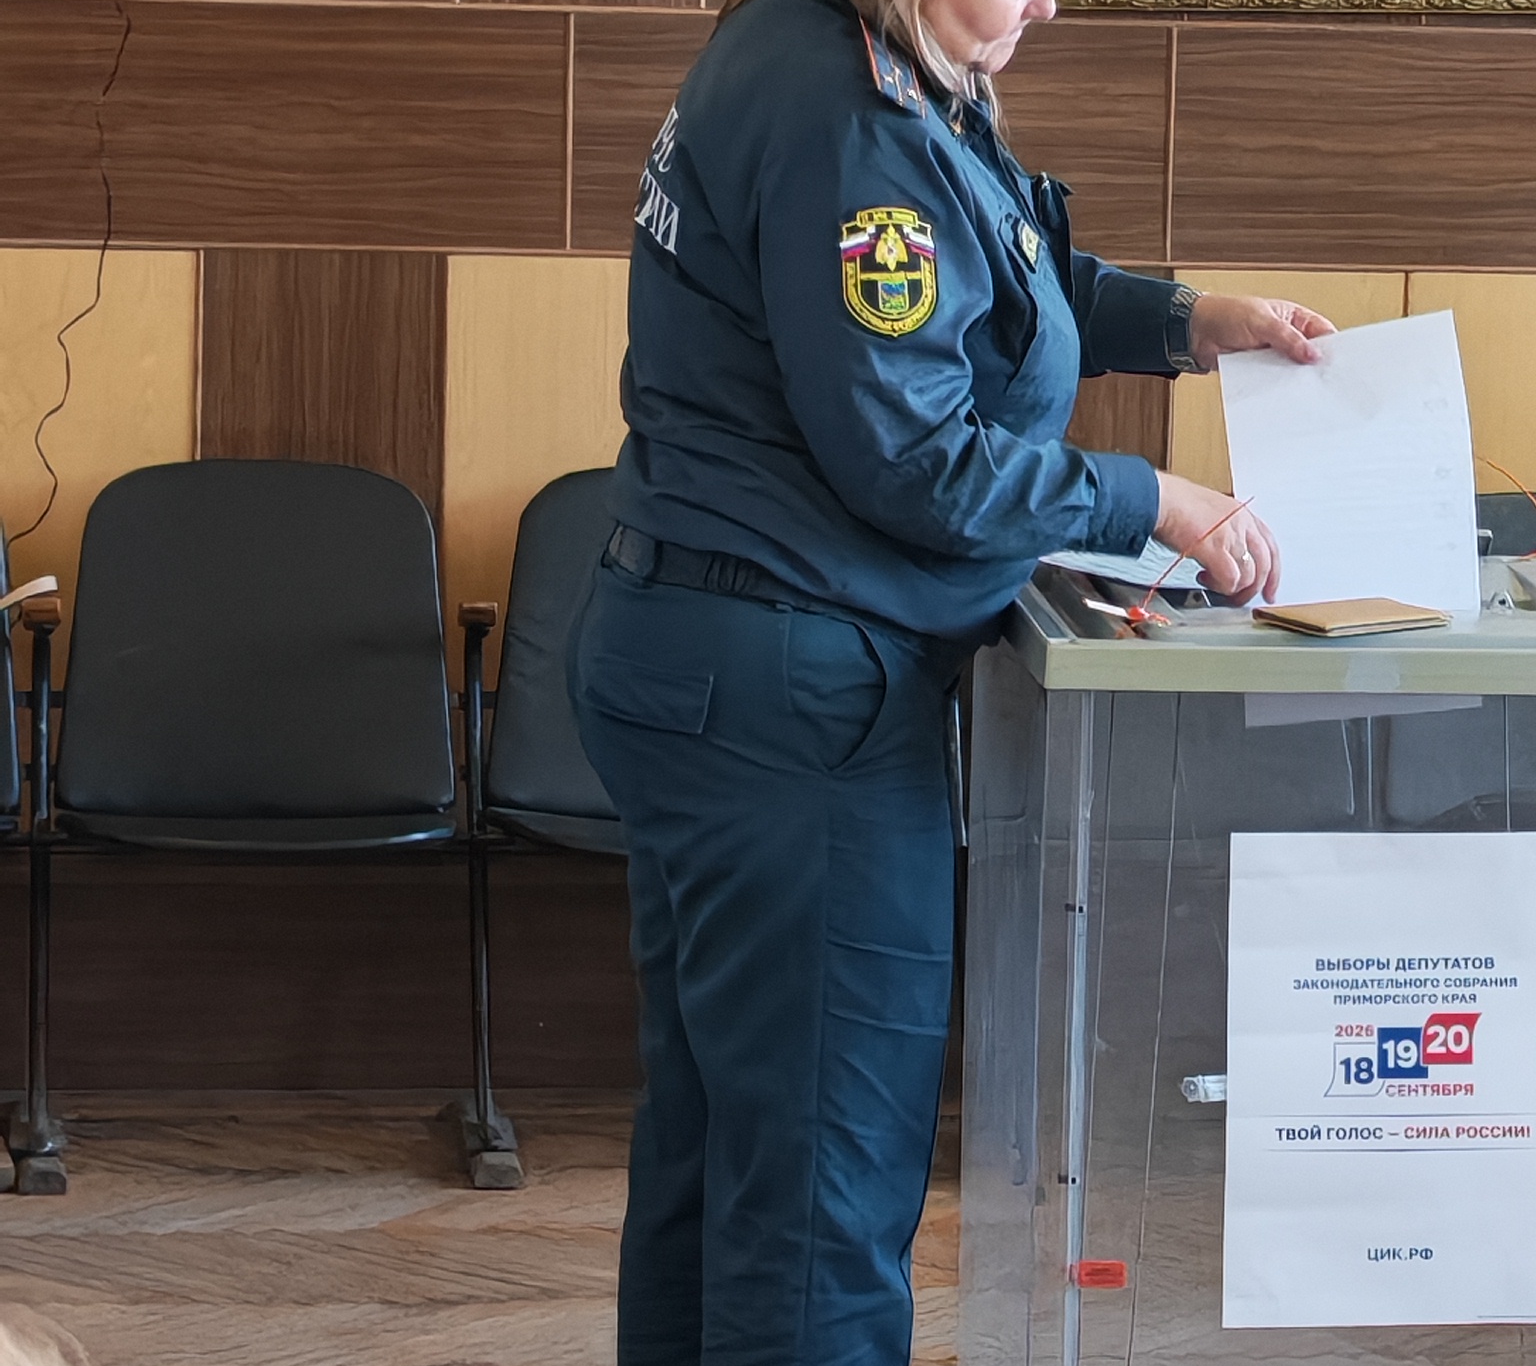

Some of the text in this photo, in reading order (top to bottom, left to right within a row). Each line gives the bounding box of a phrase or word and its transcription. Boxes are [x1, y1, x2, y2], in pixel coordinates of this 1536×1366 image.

[1314, 956, 1496, 973] ВЫБОРЫ ДЕПУТАТОВ
[1292, 977, 1518, 991] ЗАКОНОДАТЕЛЬНОГО СОБРАНИЯ
[1332, 992, 1478, 1006] ПРИМОРСКОГО КРАЯ
[1334, 1024, 1375, 1038] 2026
[1339, 1024, 1471, 1085] 18 19 20
[1385, 1083, 1475, 1097] СЕНТЯБРЯ
[1275, 1125, 1322, 1141] ТВОЙ
[1326, 1127, 1384, 1140] ГОЛОС
[1403, 1126, 1451, 1139] СИЛА
[1455, 1125, 1531, 1139] РОССИИ!
[1366, 1247, 1434, 1262] ЦИК.РФ
